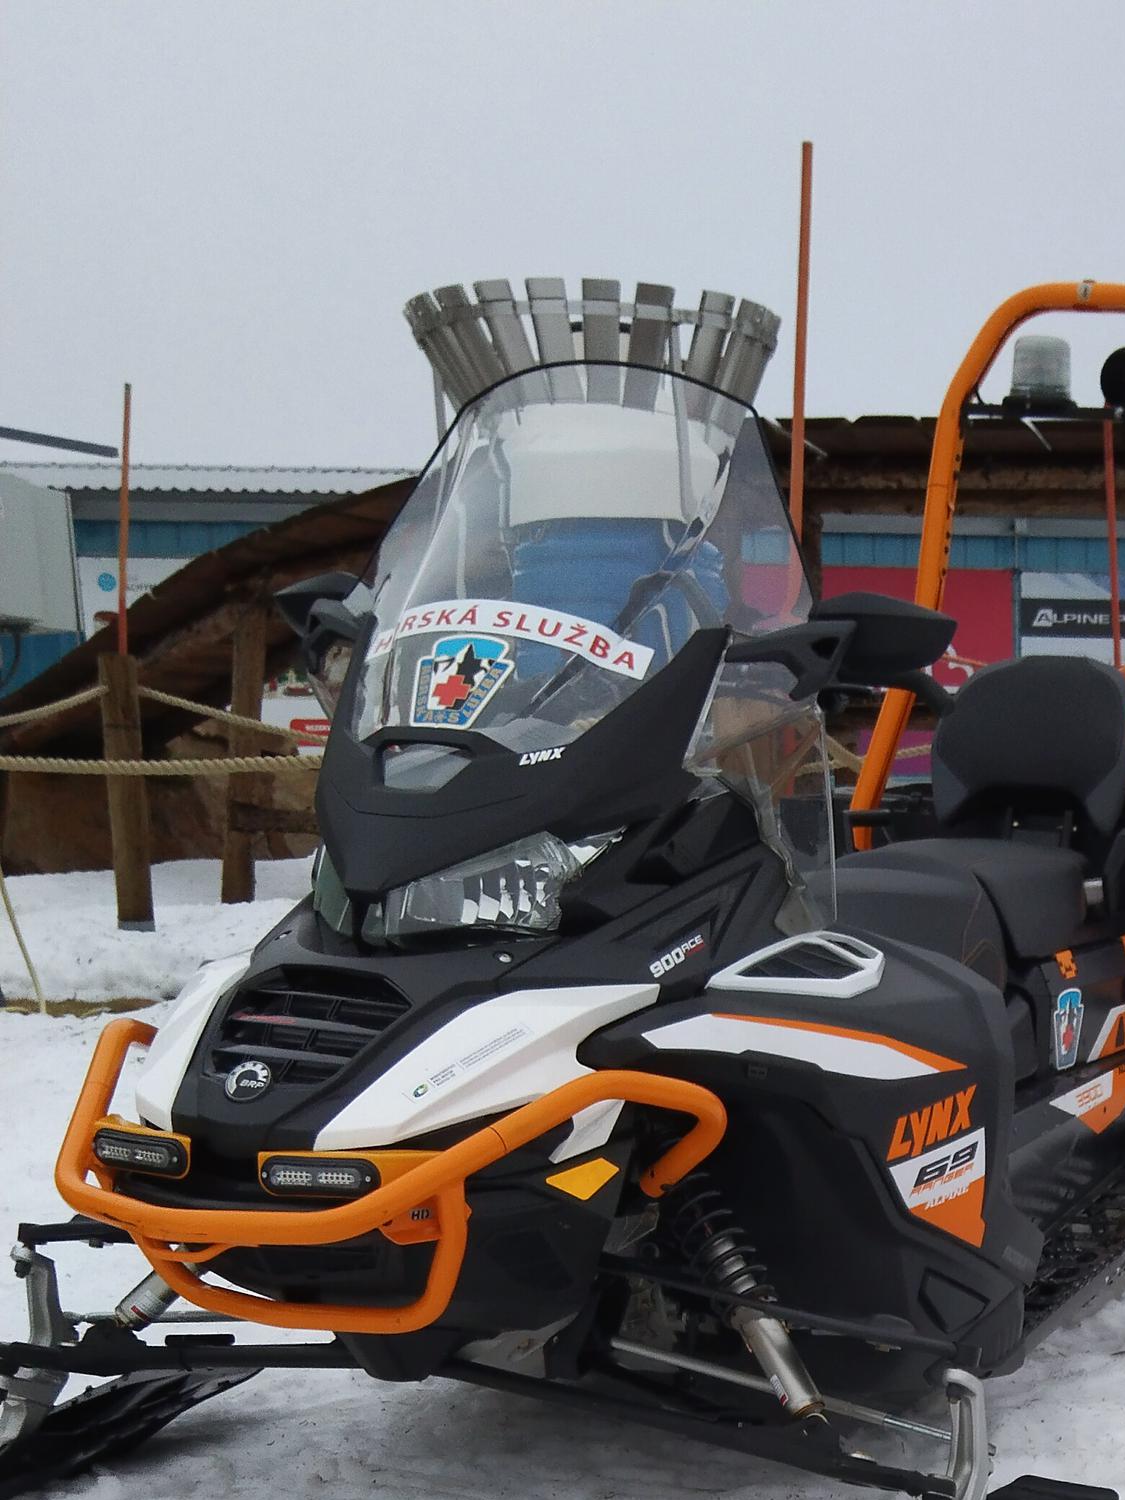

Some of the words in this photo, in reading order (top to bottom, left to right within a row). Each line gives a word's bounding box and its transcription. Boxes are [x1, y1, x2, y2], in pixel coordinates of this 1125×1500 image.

[1032, 608, 1110, 627] ALPINE
[374, 604, 478, 655] HRSKÁ
[493, 610, 634, 671] SLUŽBA
[518, 747, 566, 767] LYNX
[240, 1079, 265, 1089] BRP
[886, 1084, 978, 1162] LYNX
[913, 1140, 979, 1189] 69
[411, 1208, 431, 1221] HD
